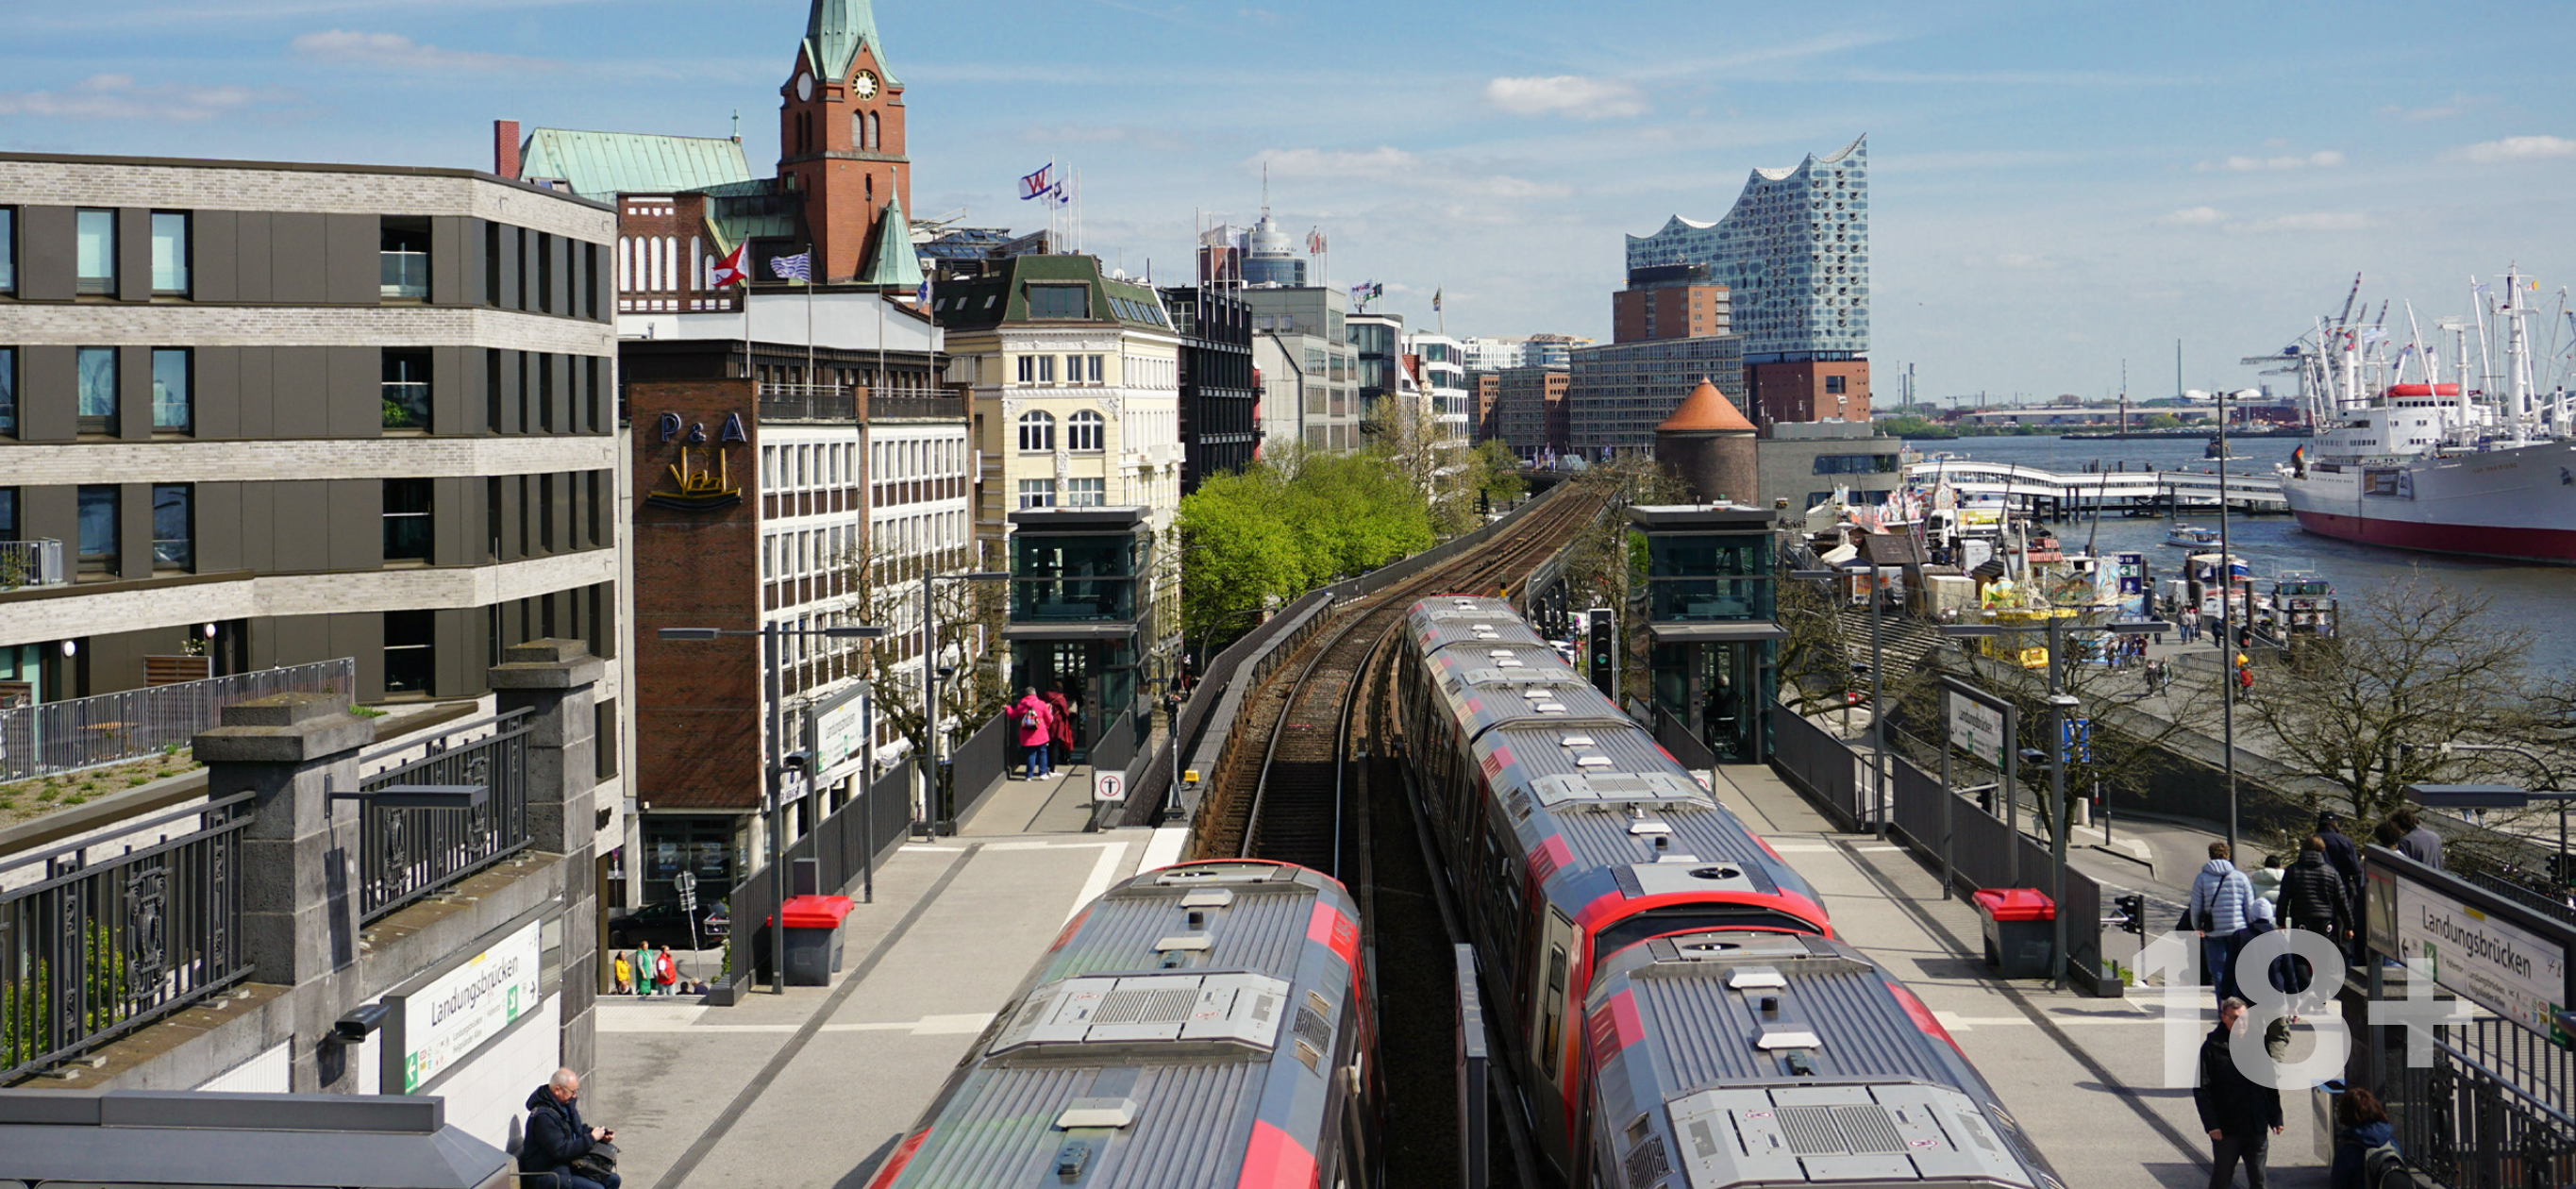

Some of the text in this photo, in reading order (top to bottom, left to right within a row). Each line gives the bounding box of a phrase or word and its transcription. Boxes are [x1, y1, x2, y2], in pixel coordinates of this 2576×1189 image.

[661, 412, 746, 444] P & A
[2422, 905, 2532, 979] Landungsbrücken
[431, 955, 518, 1027] Landungsbrücken
